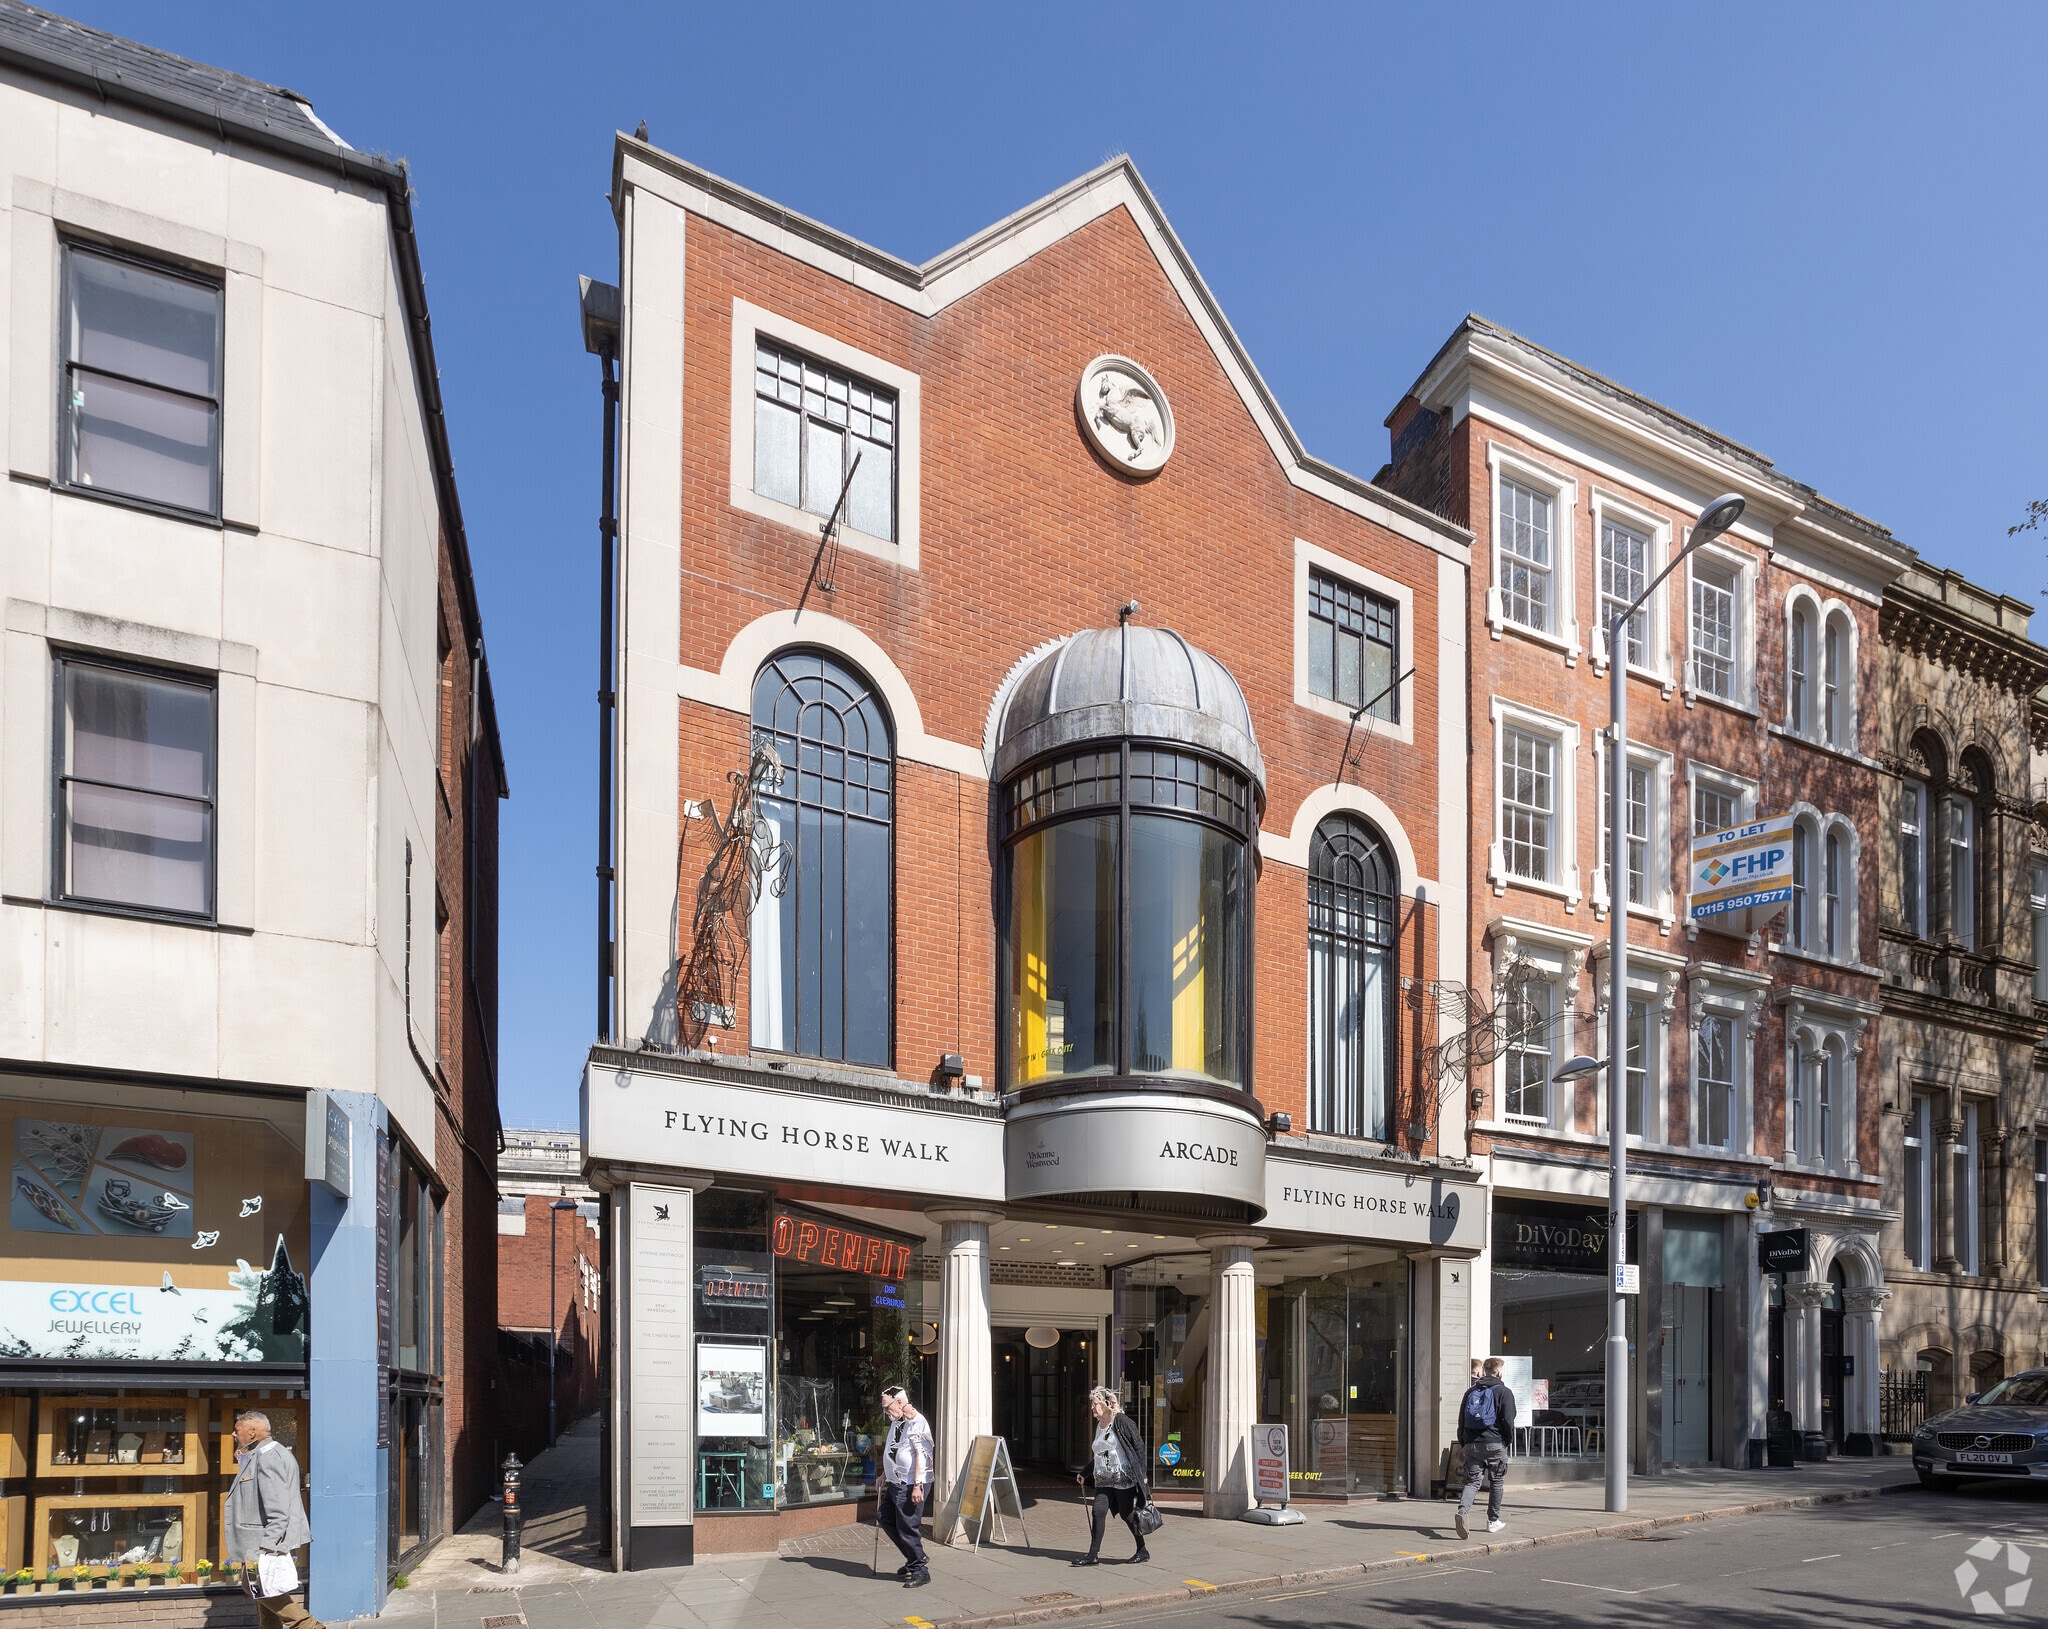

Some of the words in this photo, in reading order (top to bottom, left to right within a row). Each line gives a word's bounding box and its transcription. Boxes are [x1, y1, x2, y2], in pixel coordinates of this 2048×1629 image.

[1717, 831, 1735, 843] TO
[1740, 823, 1766, 838] LET
[1732, 849, 1784, 877] FHP
[1697, 902, 1725, 916] 0115
[1727, 896, 1752, 909] 950
[1754, 889, 1786, 902] 7577
[664, 1110, 769, 1140] FLYING
[781, 1126, 870, 1153] HORSE
[880, 1138, 949, 1162] WALK
[1025, 1156, 1060, 1169] Westwood
[1027, 1151, 1055, 1160] Vivienne
[1159, 1140, 1238, 1167] ARCADE
[1283, 1186, 1346, 1208] FLYING
[1353, 1195, 1407, 1215] HORSE
[1413, 1202, 1456, 1220] WALK
[773, 1215, 911, 1280] OPENFIT
[1516, 1223, 1606, 1253] DiVoDay
[707, 1281, 768, 1298] OPENFIT
[49, 1289, 142, 1315] EXCEL
[47, 1319, 142, 1335] JEWELLERY
[1960, 1453, 1985, 1462] FL20
[1172, 1468, 1194, 1477] COMIC
[1194, 1469, 1201, 1477] &
[1304, 1472, 1322, 1480] OUT!
